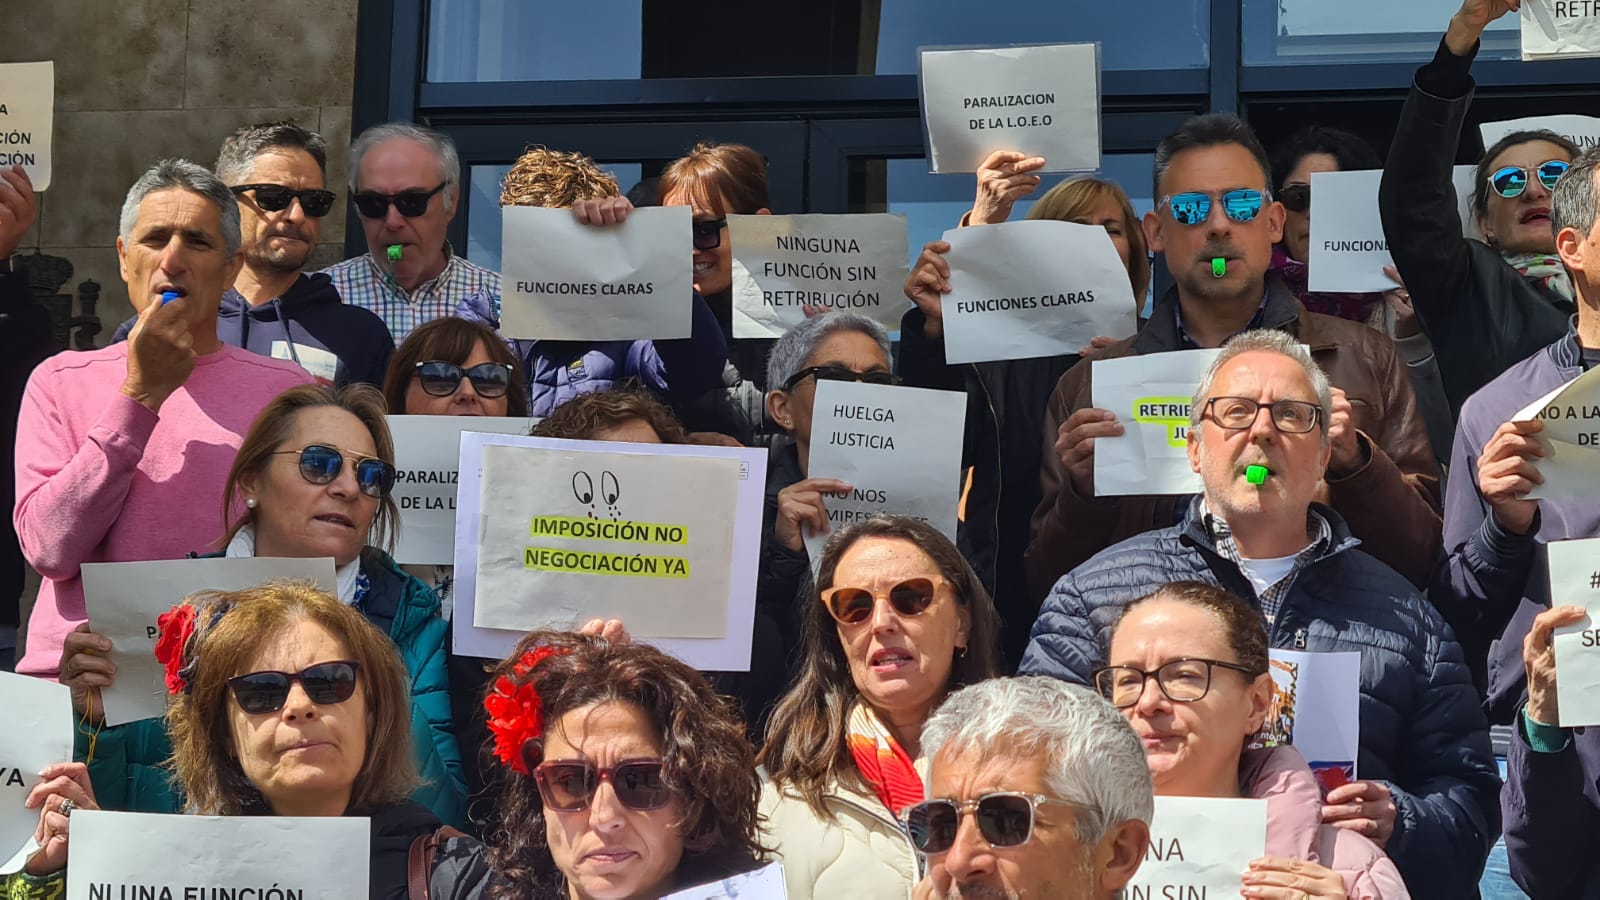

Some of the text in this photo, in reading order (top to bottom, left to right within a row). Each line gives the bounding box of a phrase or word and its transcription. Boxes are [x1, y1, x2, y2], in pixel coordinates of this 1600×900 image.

[963, 93, 1055, 109] PARALIZACION
[969, 114, 1053, 130] DE LA L.O.E.O
[776, 236, 861, 254] NINGUNA
[764, 262, 876, 281] FUNCIÓN SIN
[516, 281, 654, 295] FUNCIONES CLARAS
[763, 290, 880, 309] RETRIBUCIÓN
[957, 290, 1095, 314] FUNCIONES CLARAS
[833, 404, 895, 423] HUELGA
[1566, 406, 1577, 419] A
[1582, 405, 1600, 419] LA
[829, 431, 895, 450] JUSTICIA
[1578, 432, 1600, 445] DE
[401, 496, 421, 510] DE
[425, 497, 444, 510] LA
[853, 488, 887, 503] NOS
[533, 518, 683, 542] IMPOSICIÓN NO
[525, 549, 687, 574] NEGOCIACIÓN YA
[89, 882, 304, 900] NI UNA FUNCIÓN
[1162, 884, 1207, 900] SIN
